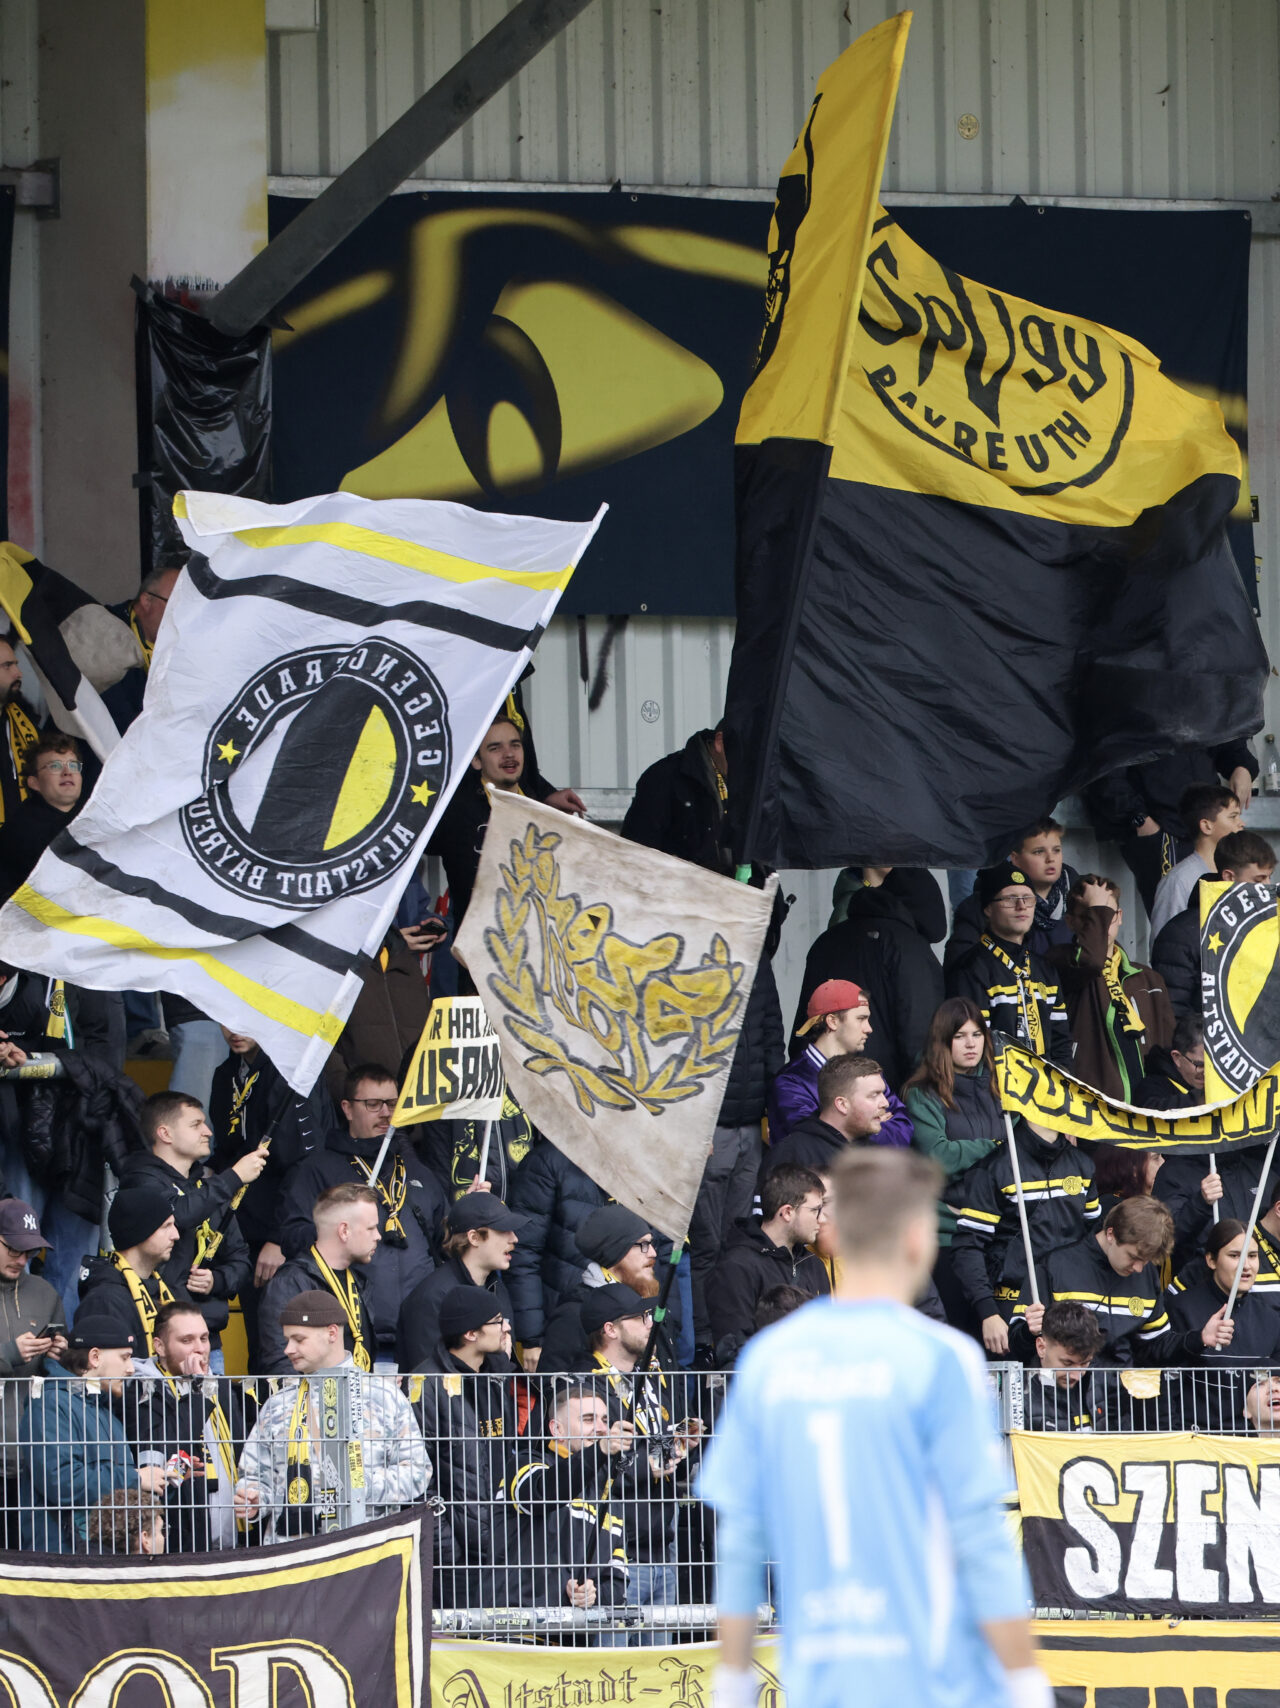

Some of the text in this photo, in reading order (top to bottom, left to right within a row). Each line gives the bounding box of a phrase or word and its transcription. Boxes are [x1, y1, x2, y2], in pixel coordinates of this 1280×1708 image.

[868, 363, 1093, 474] BAYREUTH
[1200, 970, 1263, 1090] ALTSTADT
[402, 1043, 505, 1109] USAM
[23, 1213, 37, 1231] NY
[806, 1408, 850, 1570] 1
[442, 1656, 722, 1708] Altstadt-K
